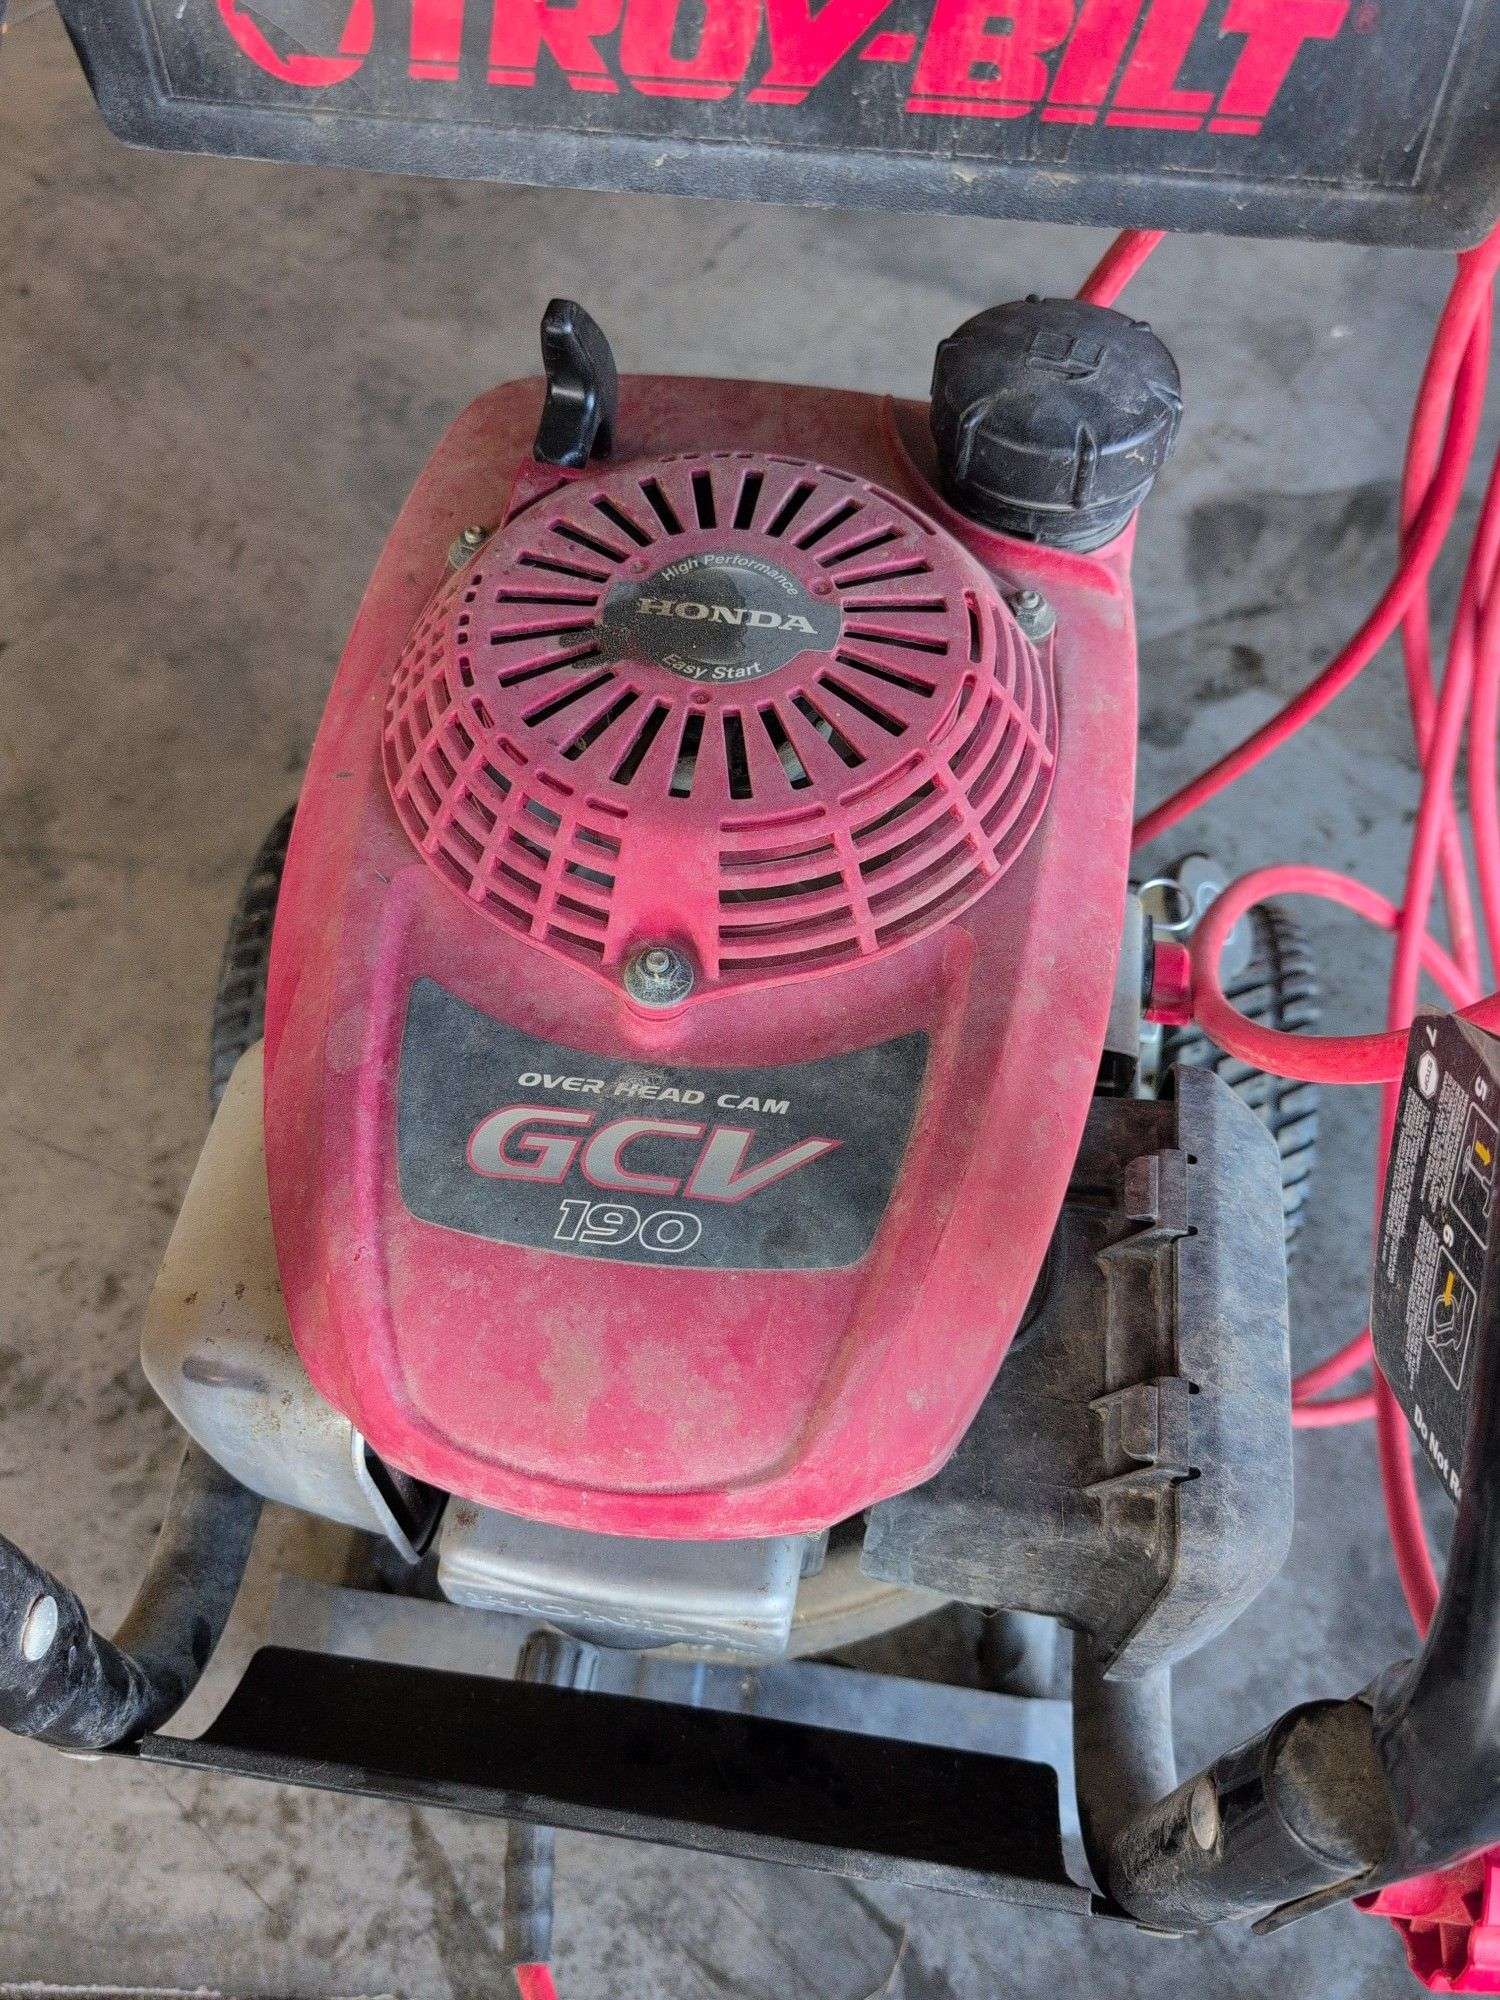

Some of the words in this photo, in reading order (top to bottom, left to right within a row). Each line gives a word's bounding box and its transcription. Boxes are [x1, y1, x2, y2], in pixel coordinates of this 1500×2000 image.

[661, 558, 699, 582] High
[704, 554, 799, 596] Performance
[637, 597, 818, 635] HONDA
[663, 653, 708, 680] Easy
[712, 661, 762, 681] Start
[517, 1072, 604, 1095] OVER
[613, 1081, 705, 1105] HEAD
[717, 1093, 790, 1115] CAM
[467, 1104, 841, 1203] GCV
[554, 1199, 702, 1253] 190
[1413, 1403, 1428, 1440] Do
[1429, 1431, 1449, 1480] Not
